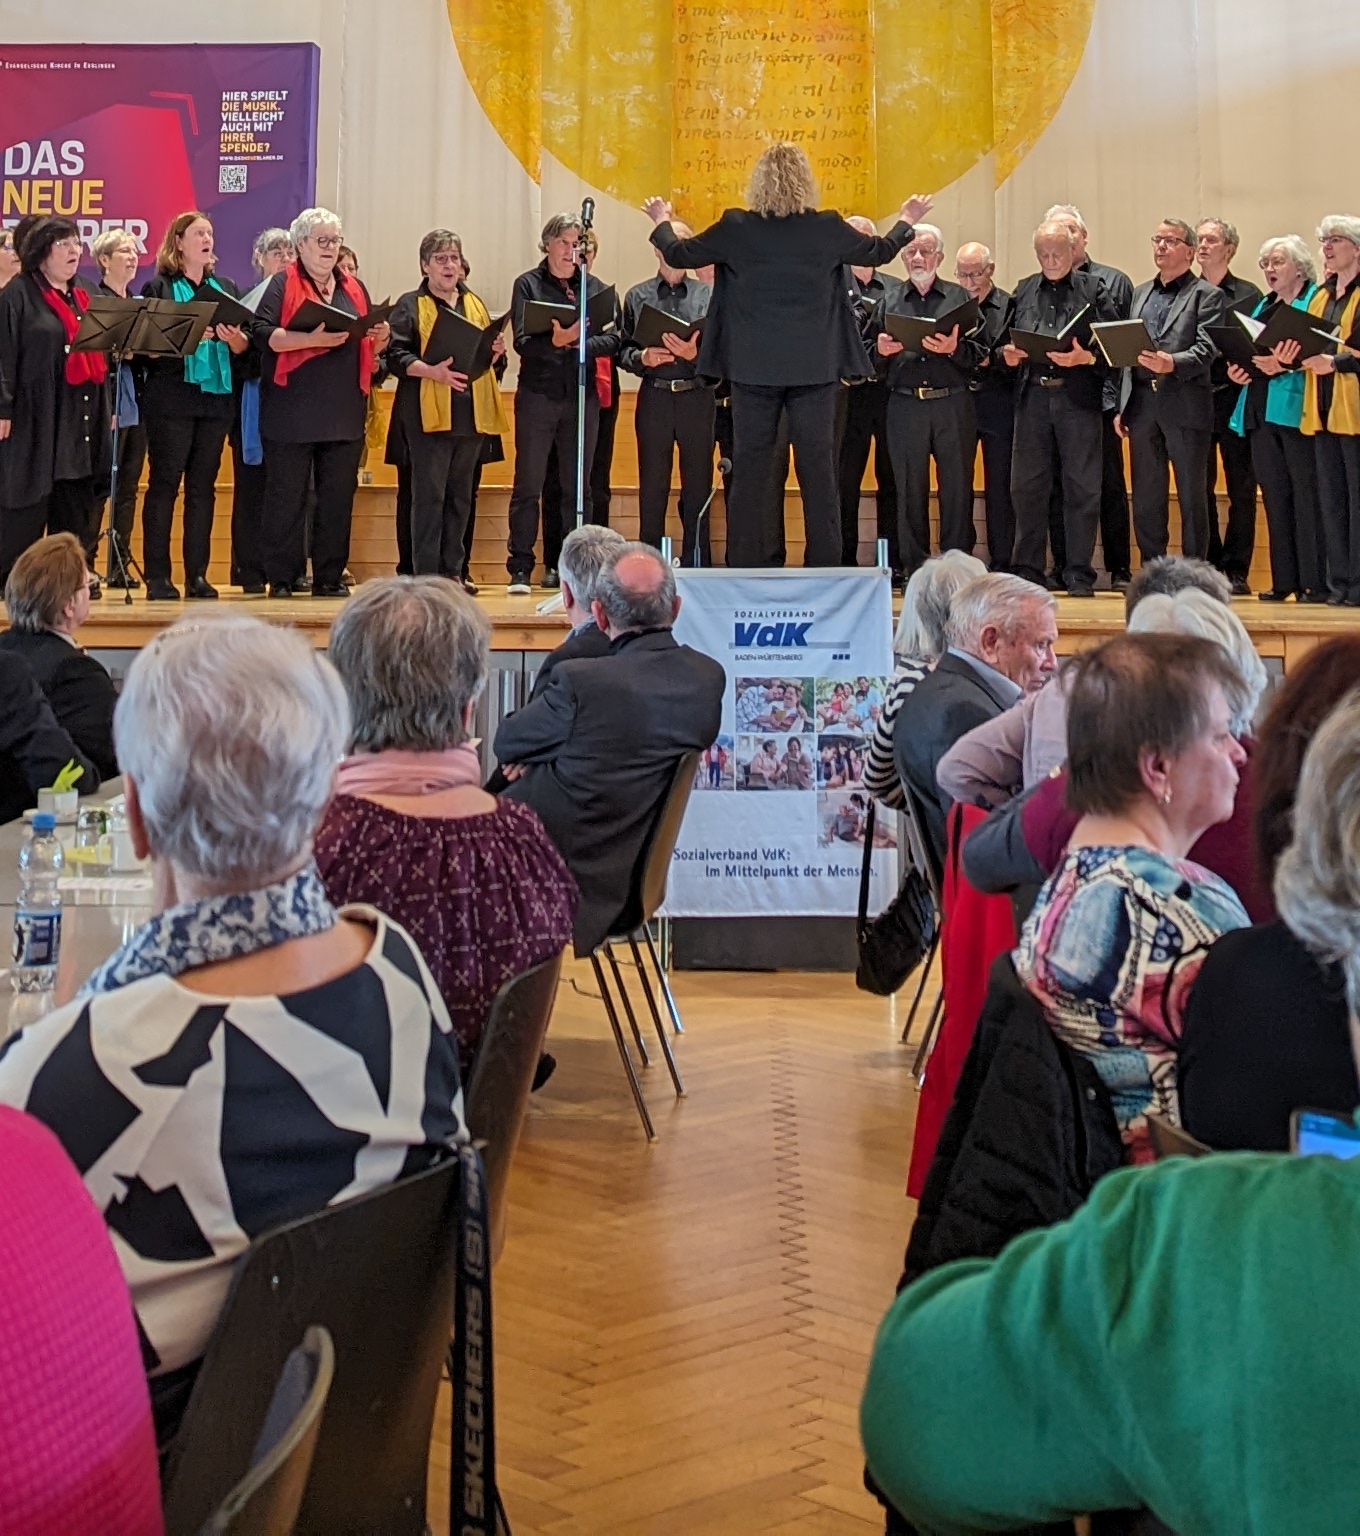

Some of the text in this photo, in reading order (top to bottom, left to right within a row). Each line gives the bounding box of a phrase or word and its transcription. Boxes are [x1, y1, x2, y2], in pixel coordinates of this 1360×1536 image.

[222, 90, 288, 101] HIER SPIELT
[221, 101, 281, 111] DIE MUSIK.
[220, 111, 284, 121] VIELLEICHT
[220, 122, 273, 132] AUCH MIT
[220, 132, 254, 142] IHRER
[219, 143, 270, 153] SPENDE?
[4, 139, 85, 176] DAS
[2, 179, 104, 215] NEUE
[734, 610, 815, 618] SOZIALVERBAND
[734, 622, 814, 647] VdK
[673, 847, 791, 861] Sozialverband VdK:
[705, 864, 720, 877] Im
[725, 864, 799, 880] Mittelpunkt
[803, 864, 823, 877] der
[463, 1284, 485, 1520] SKECHERS
